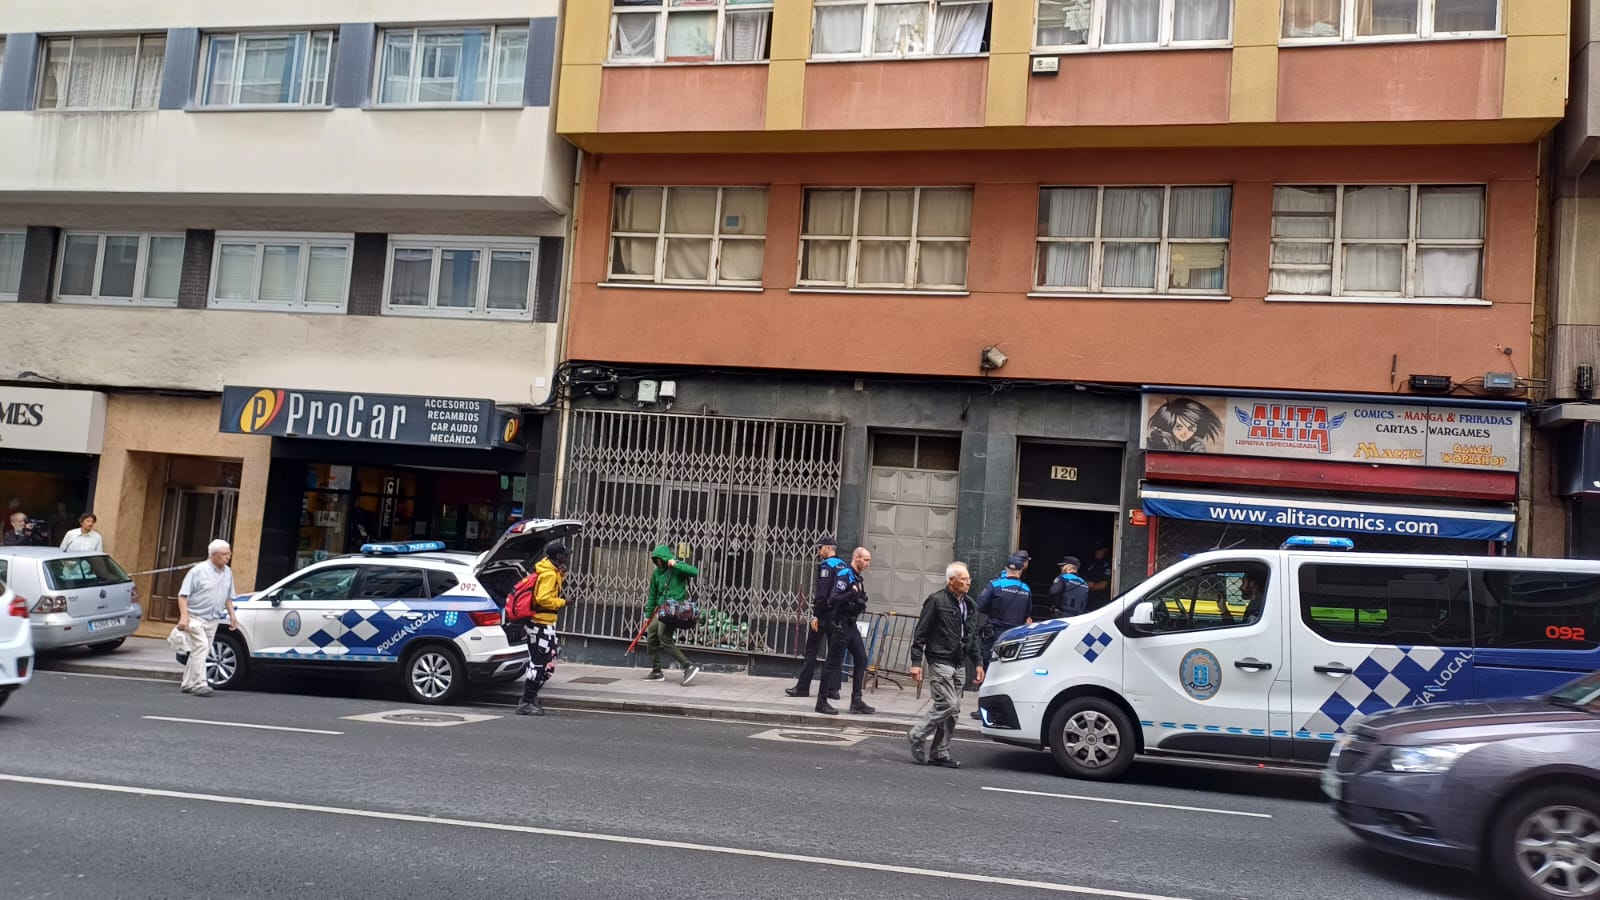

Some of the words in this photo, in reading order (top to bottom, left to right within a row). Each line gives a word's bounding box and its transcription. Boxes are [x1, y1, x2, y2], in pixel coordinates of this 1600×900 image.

[425, 399, 480, 410] ACCESORIOS
[286, 393, 406, 440] ProCar
[428, 411, 480, 422] RECAMBIOS
[1354, 409, 1394, 419] COMICS
[1404, 411, 1443, 423] MANGA
[1446, 412, 1456, 423] &
[1459, 414, 1513, 426] FRIKADAS
[431, 422, 449, 432] CAR
[450, 423, 478, 433] AUDIO
[1253, 419, 1326, 429] COMICS
[1375, 424, 1418, 435] CARTAS
[1428, 426, 1490, 438] WARGAMES
[430, 433, 477, 445] MECÁNICA
[1453, 443, 1493, 455] GAMES
[1440, 452, 1506, 466] WORKSHOP
[1053, 467, 1077, 480] 120
[1209, 507, 1439, 535] www.alitacomics.com
[460, 582, 477, 592] 092
[410, 610, 440, 631] LOCAL
[1545, 625, 1585, 640] 092
[1434, 652, 1473, 687] LOCAL
